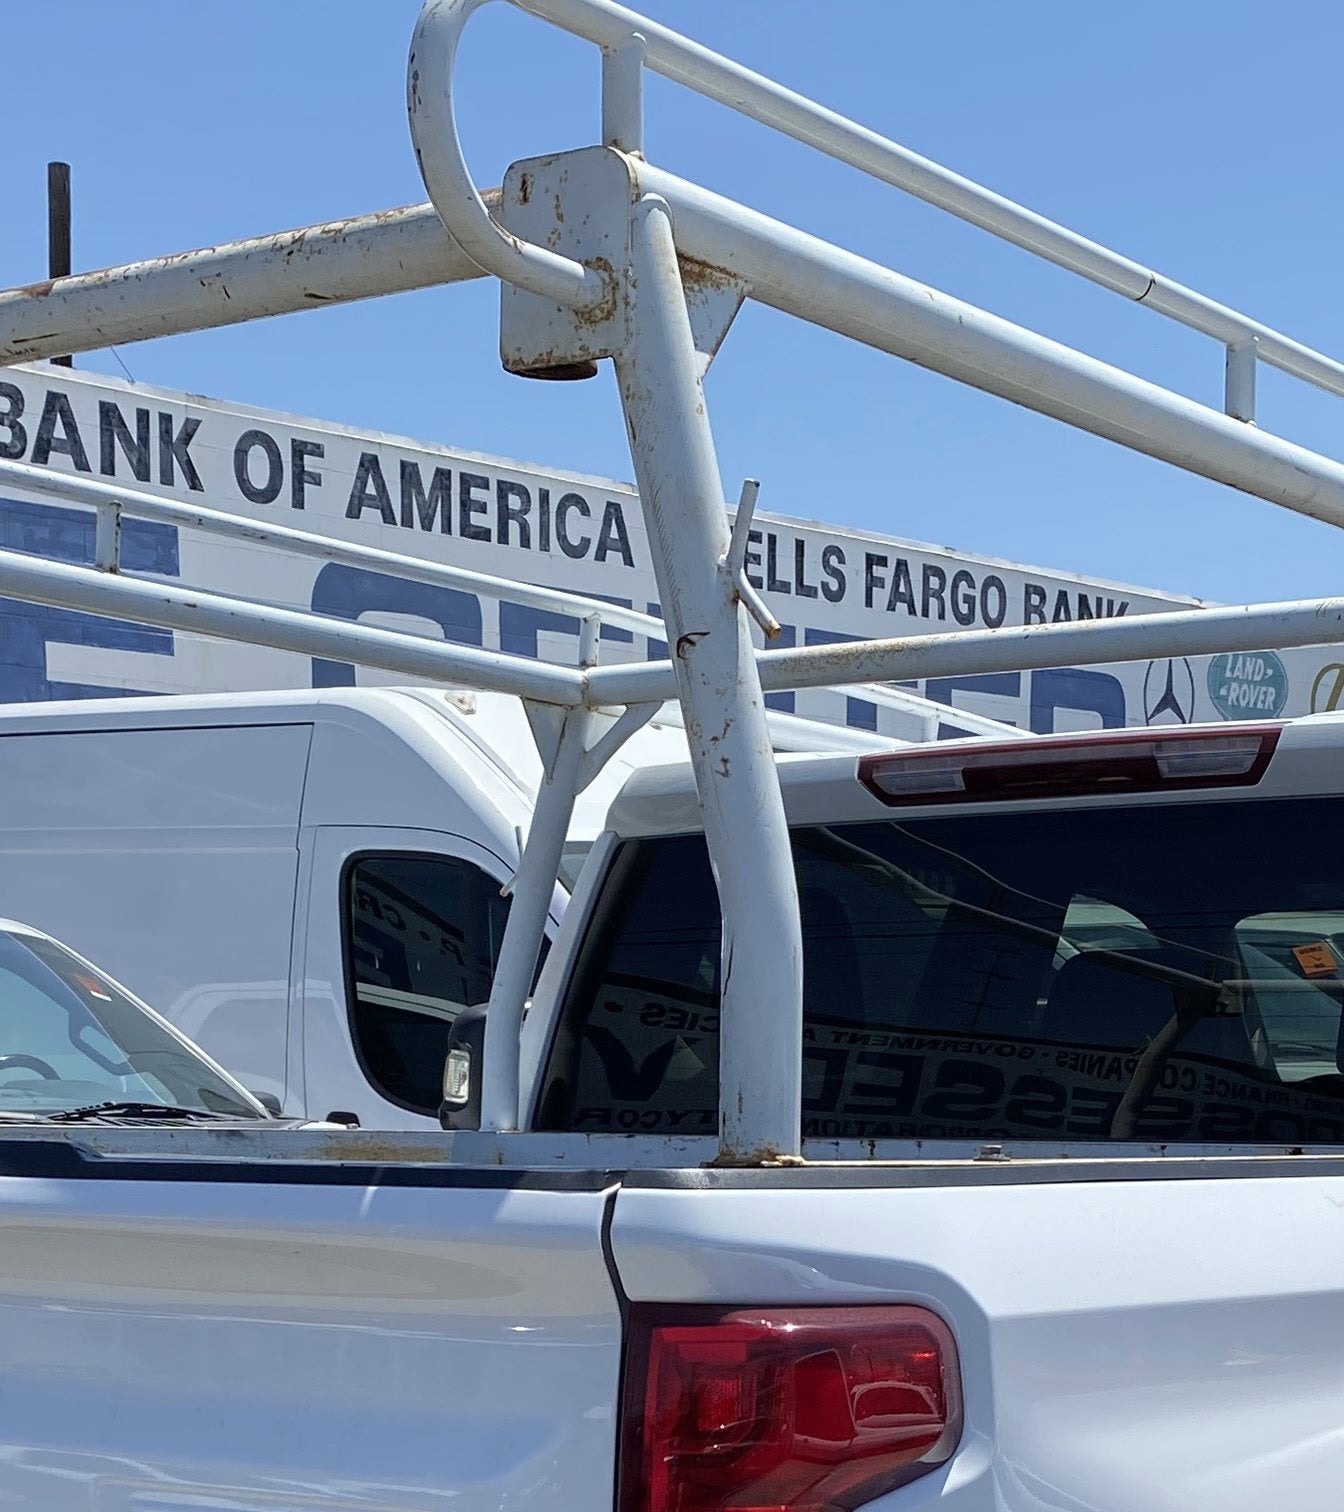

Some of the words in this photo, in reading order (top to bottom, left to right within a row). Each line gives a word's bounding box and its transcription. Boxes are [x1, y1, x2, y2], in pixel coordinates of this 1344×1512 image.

[234, 429, 325, 510] OF
[345, 453, 636, 568] AMERICA
[731, 525, 846, 603] ELLS
[864, 551, 1008, 629] FARGO
[1225, 654, 1265, 682] LAND
[1227, 682, 1277, 711] ROVER
